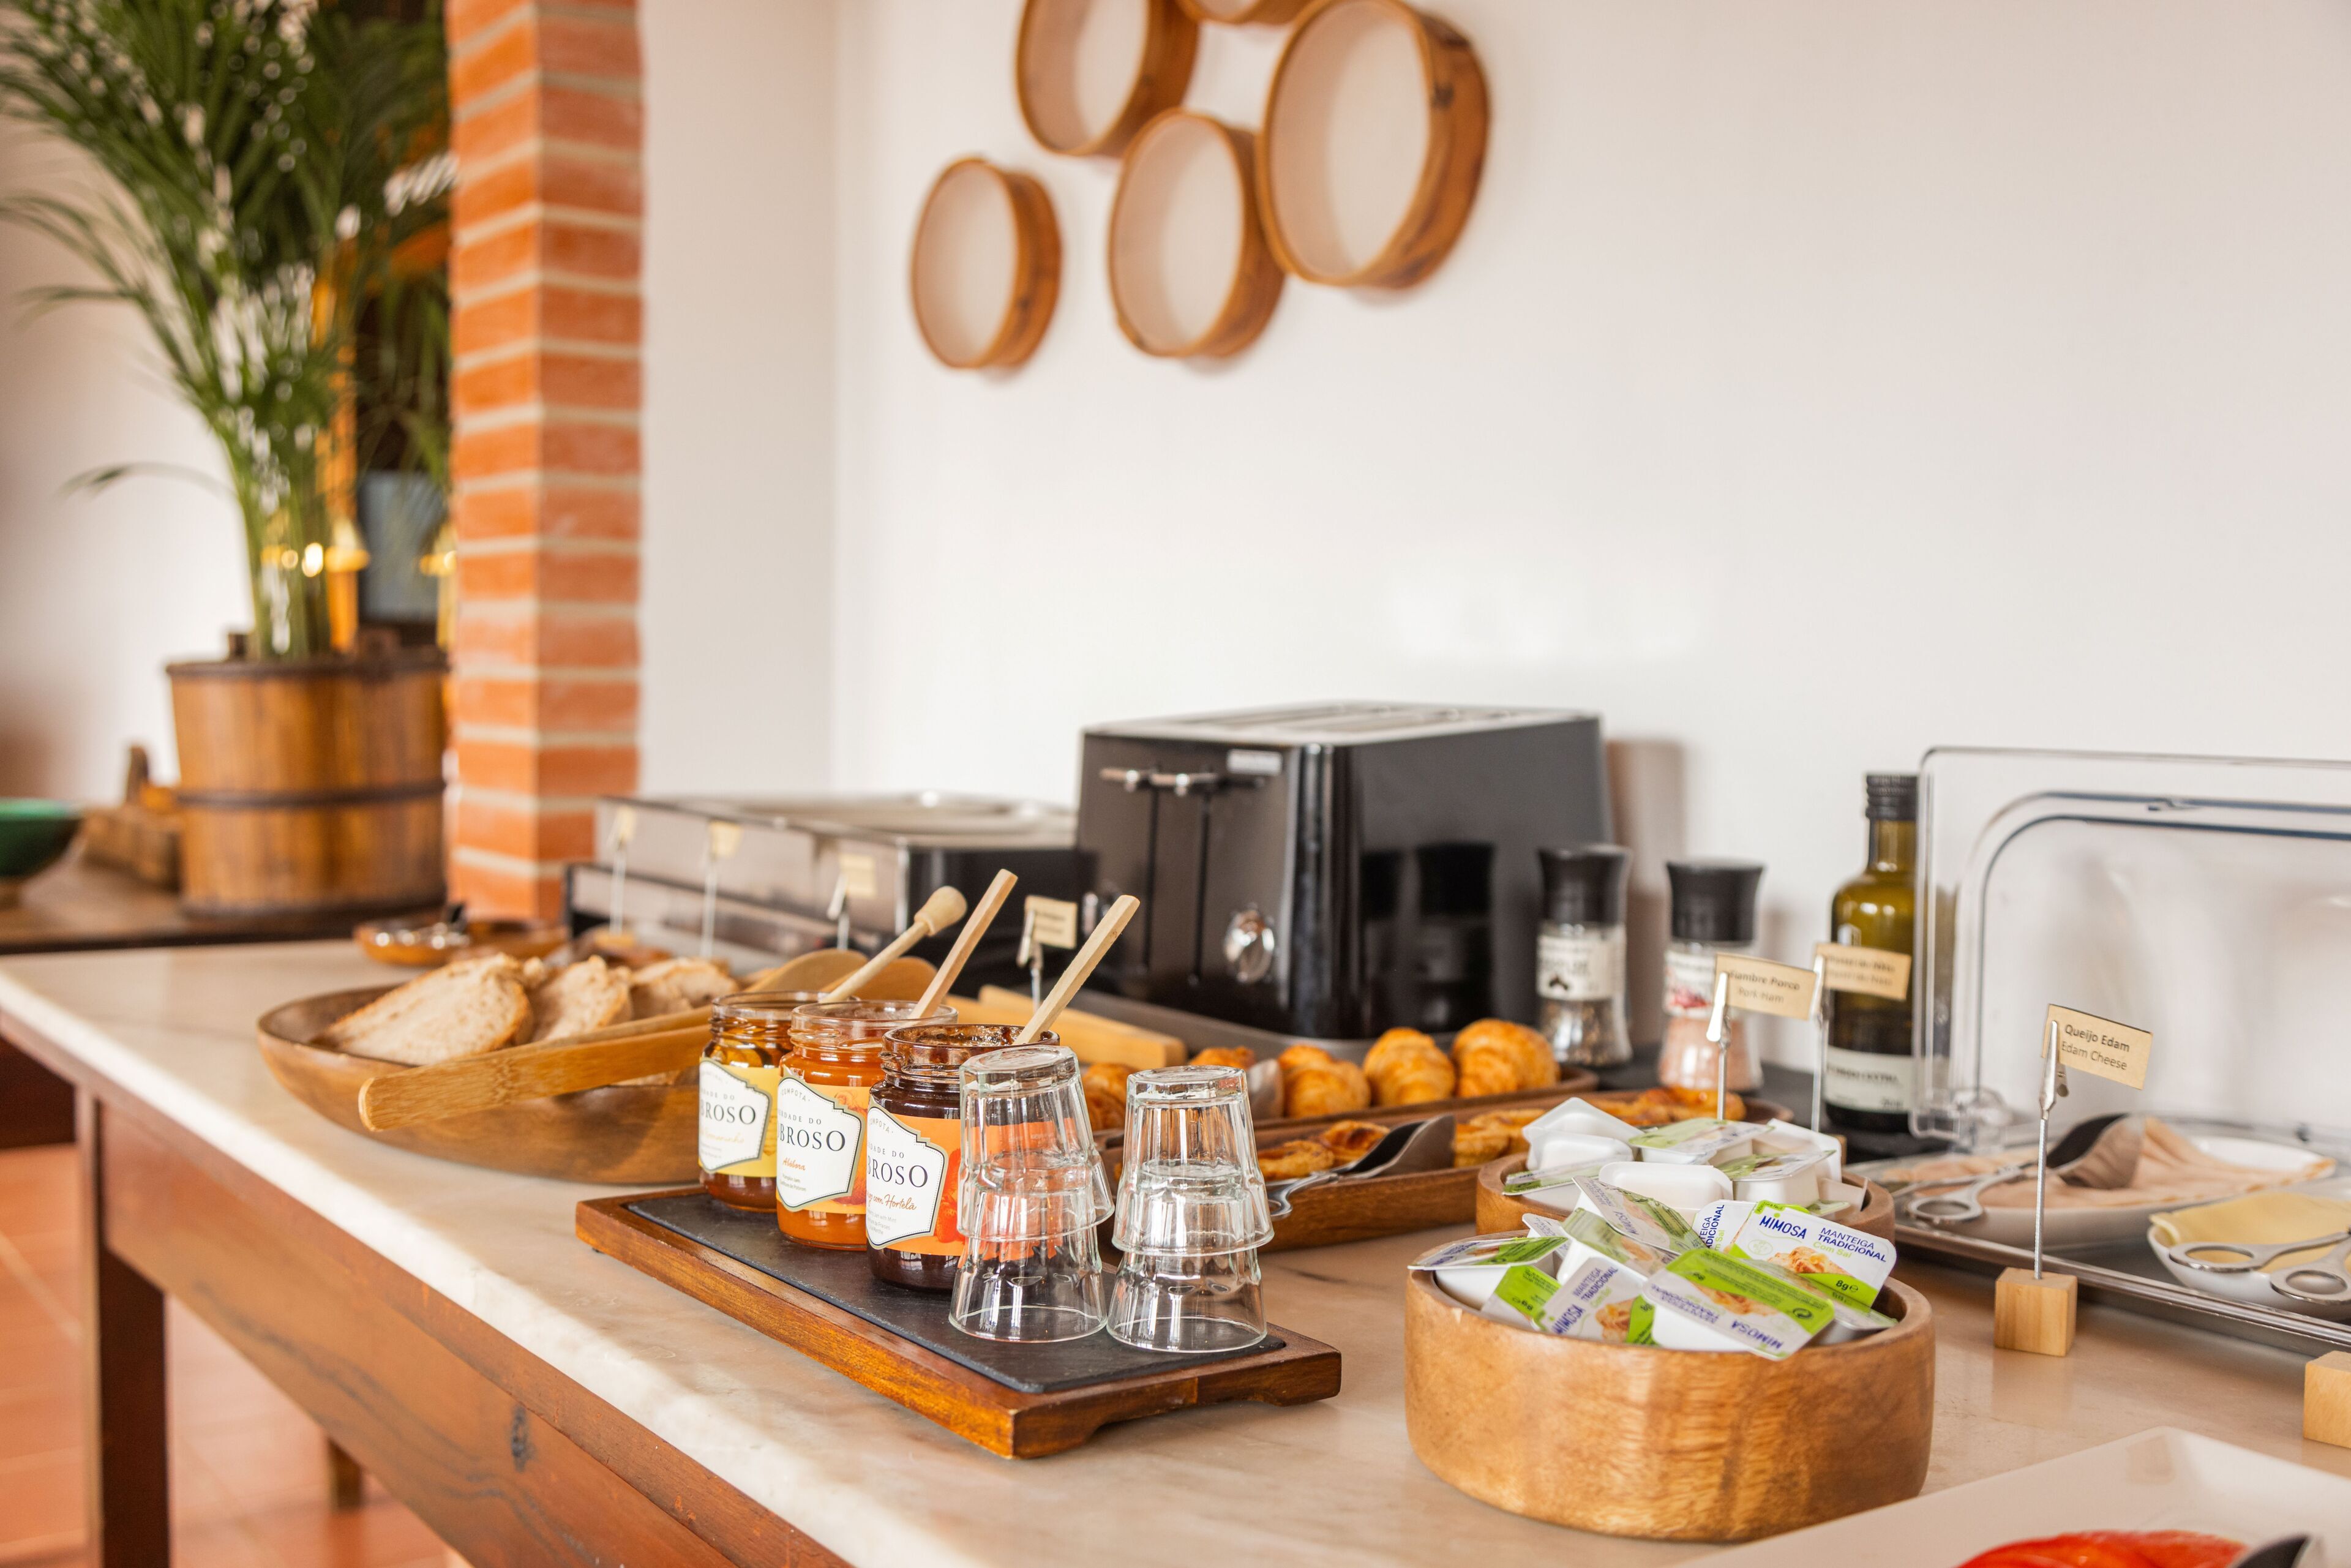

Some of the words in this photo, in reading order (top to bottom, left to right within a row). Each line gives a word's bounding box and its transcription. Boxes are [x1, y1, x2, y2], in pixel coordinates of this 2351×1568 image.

[1770, 977, 1801, 991] Porco
[2065, 1024, 2099, 1043] Queijo
[2101, 1035, 2130, 1052] Edam
[2061, 1041, 2088, 1059] Edam
[2091, 1051, 2128, 1071] Cheese
[778, 1123, 846, 1152] BROSO
[892, 1150, 904, 1159] DO
[1699, 1217, 1712, 1240] TEIGA
[1705, 1204, 1725, 1249] ADICIONAL
[1715, 1229, 1725, 1242] Sal
[1759, 1215, 1807, 1239] MIMOSA
[1820, 1227, 1875, 1250] MANTEIGA
[1813, 1241, 1835, 1253] Com
[1836, 1248, 1853, 1259] Sal
[1818, 1234, 1886, 1262] TRADICIONAL
[1581, 1266, 1618, 1302] TRADICIONAL
[1551, 1303, 1586, 1335] MIMOSA
[1730, 1318, 1784, 1349] MIMOSA
